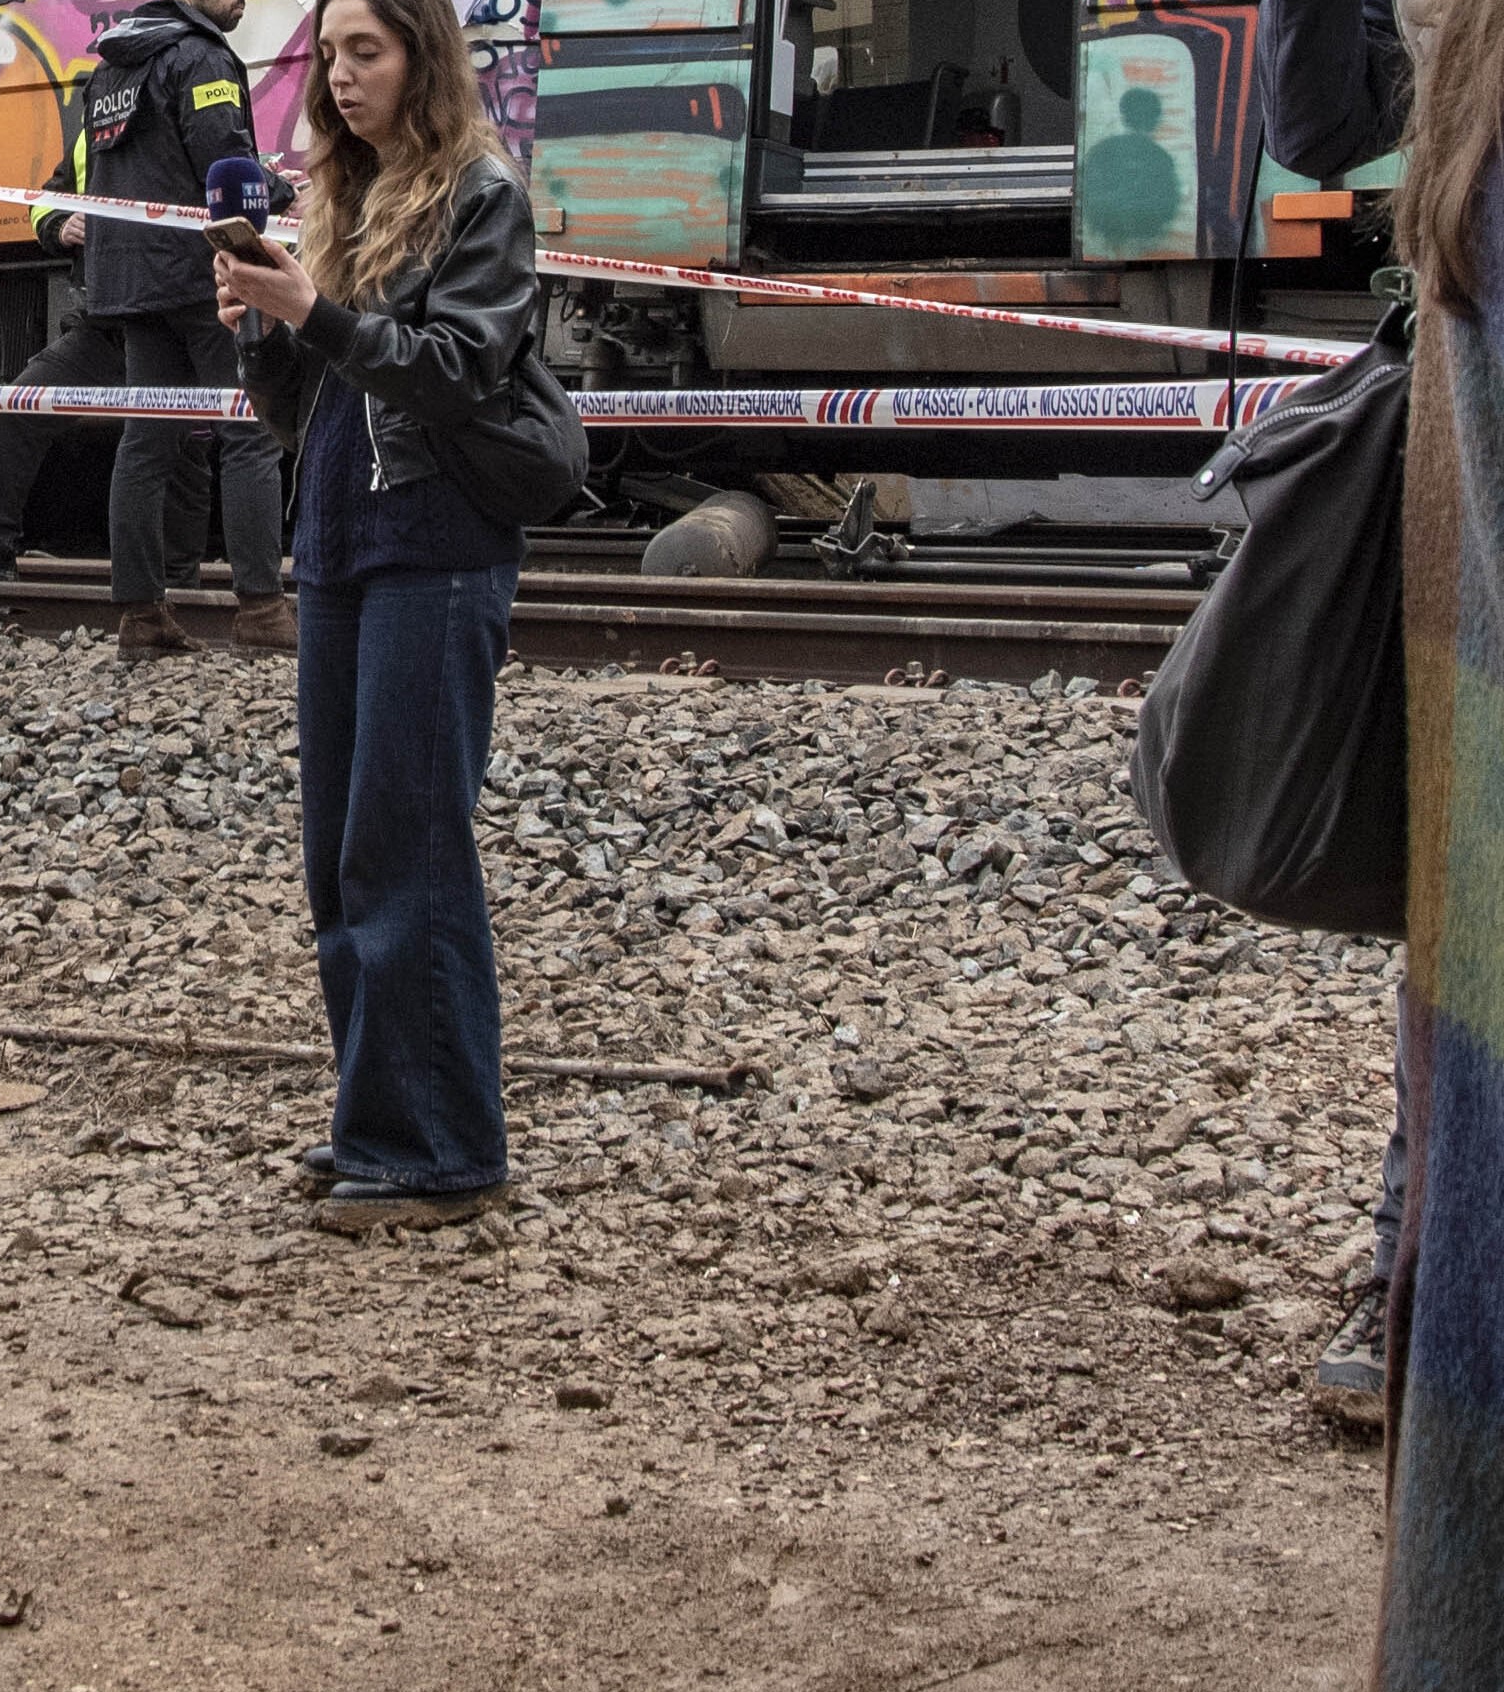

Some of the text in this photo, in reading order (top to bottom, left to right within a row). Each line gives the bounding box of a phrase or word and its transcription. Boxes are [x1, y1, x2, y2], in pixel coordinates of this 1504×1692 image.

[244, 183, 267, 196] TF1
[242, 198, 269, 210] INFO
[676, 391, 723, 416] MOSSOS
[894, 390, 913, 416] NO
[915, 389, 967, 416] PASSEU
[977, 388, 1030, 416] POLICIA
[1040, 387, 1099, 417] MOSSOS
[1102, 386, 1197, 418] D'ESQUADRA
